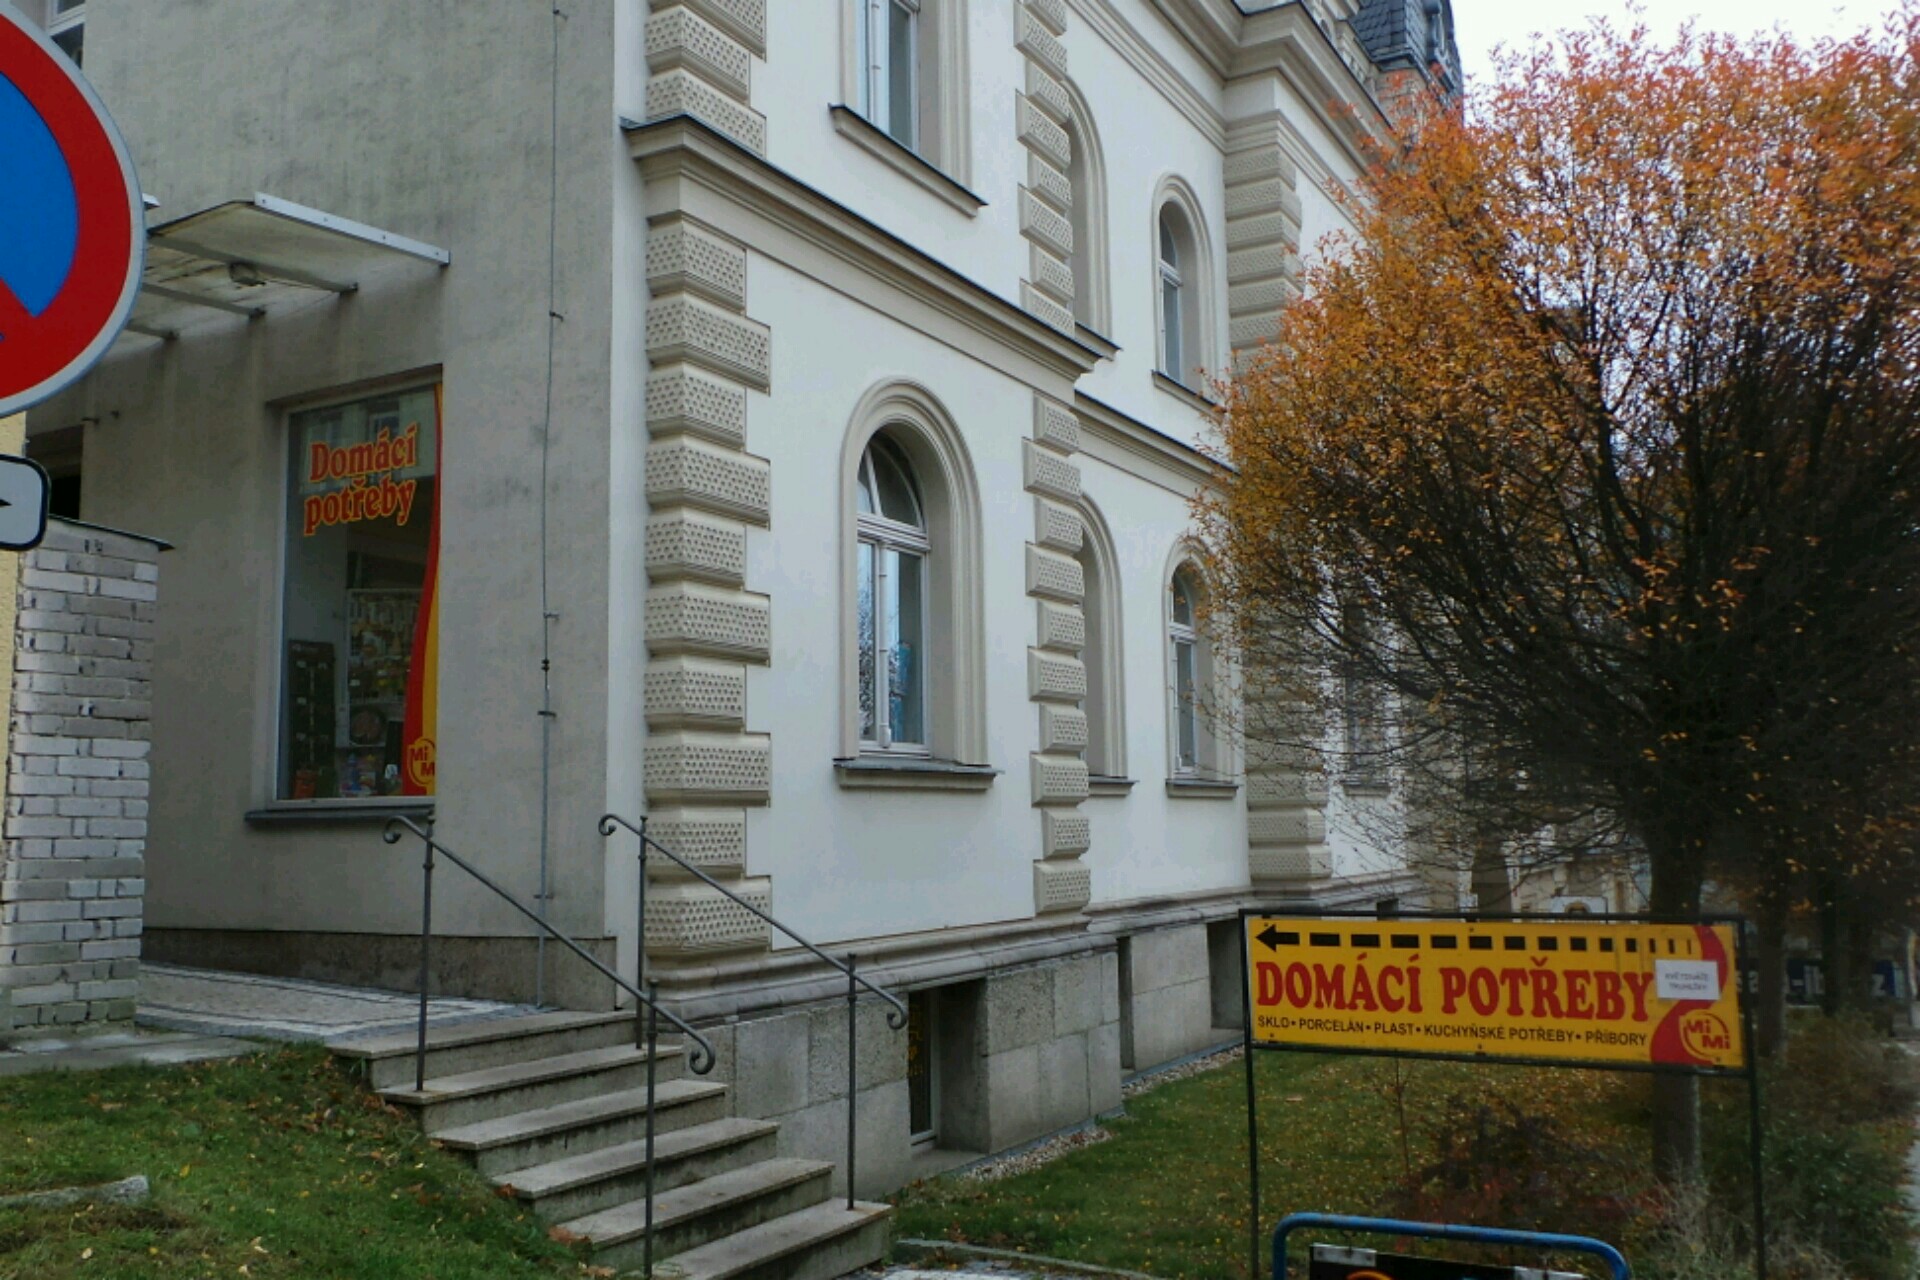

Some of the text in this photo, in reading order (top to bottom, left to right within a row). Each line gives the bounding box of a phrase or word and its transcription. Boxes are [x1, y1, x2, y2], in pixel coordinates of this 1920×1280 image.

[309, 421, 417, 482] Domácí
[303, 473, 416, 537] potřeby
[420, 761, 436, 777] M
[1255, 952, 1654, 1022] DOMÁCÍ POTŘEBY
[1257, 1015, 1290, 1028] SKLO
[1299, 1017, 1364, 1033] PORCELÁN
[1374, 1022, 1414, 1036] PLAST
[1508, 1026, 1575, 1043] POTŘEBY
[1585, 1030, 1648, 1047] PŘÍBORY
[1686, 1019, 1711, 1034] Mi
[1702, 1034, 1730, 1050] Mi
